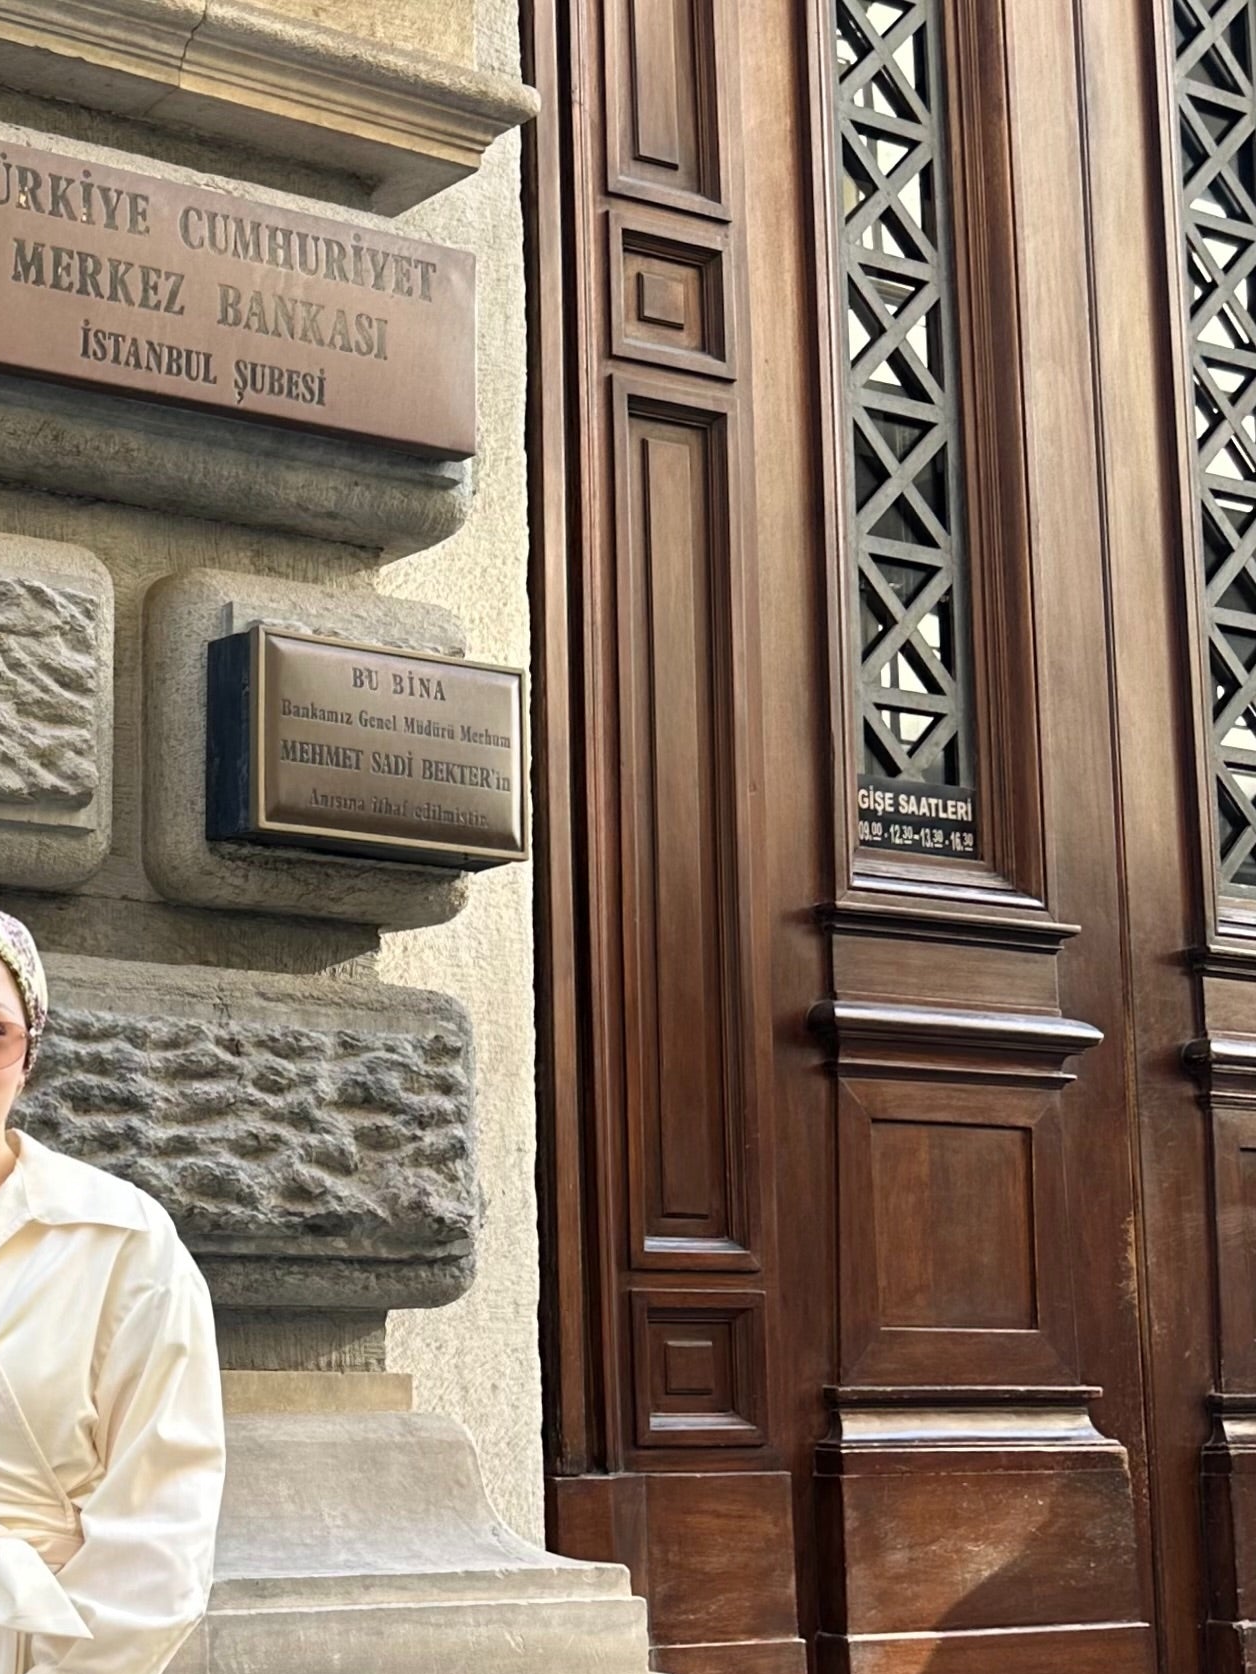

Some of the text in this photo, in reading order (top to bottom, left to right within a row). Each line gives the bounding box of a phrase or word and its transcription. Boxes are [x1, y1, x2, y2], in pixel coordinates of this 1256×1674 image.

[179, 205, 437, 303] CUMHURİYET
[12, 238, 389, 361] MERKEZ BANKASI
[80, 318, 326, 407] İSTANBUL ŞUBESİ
[351, 667, 447, 702] BU BİNA
[281, 699, 511, 749] Bankamız Genel Müdürü Merhum
[280, 738, 364, 771] MEHMET
[371, 751, 414, 778] SADİ
[858, 785, 972, 822] GİŞE SAATLERİ
